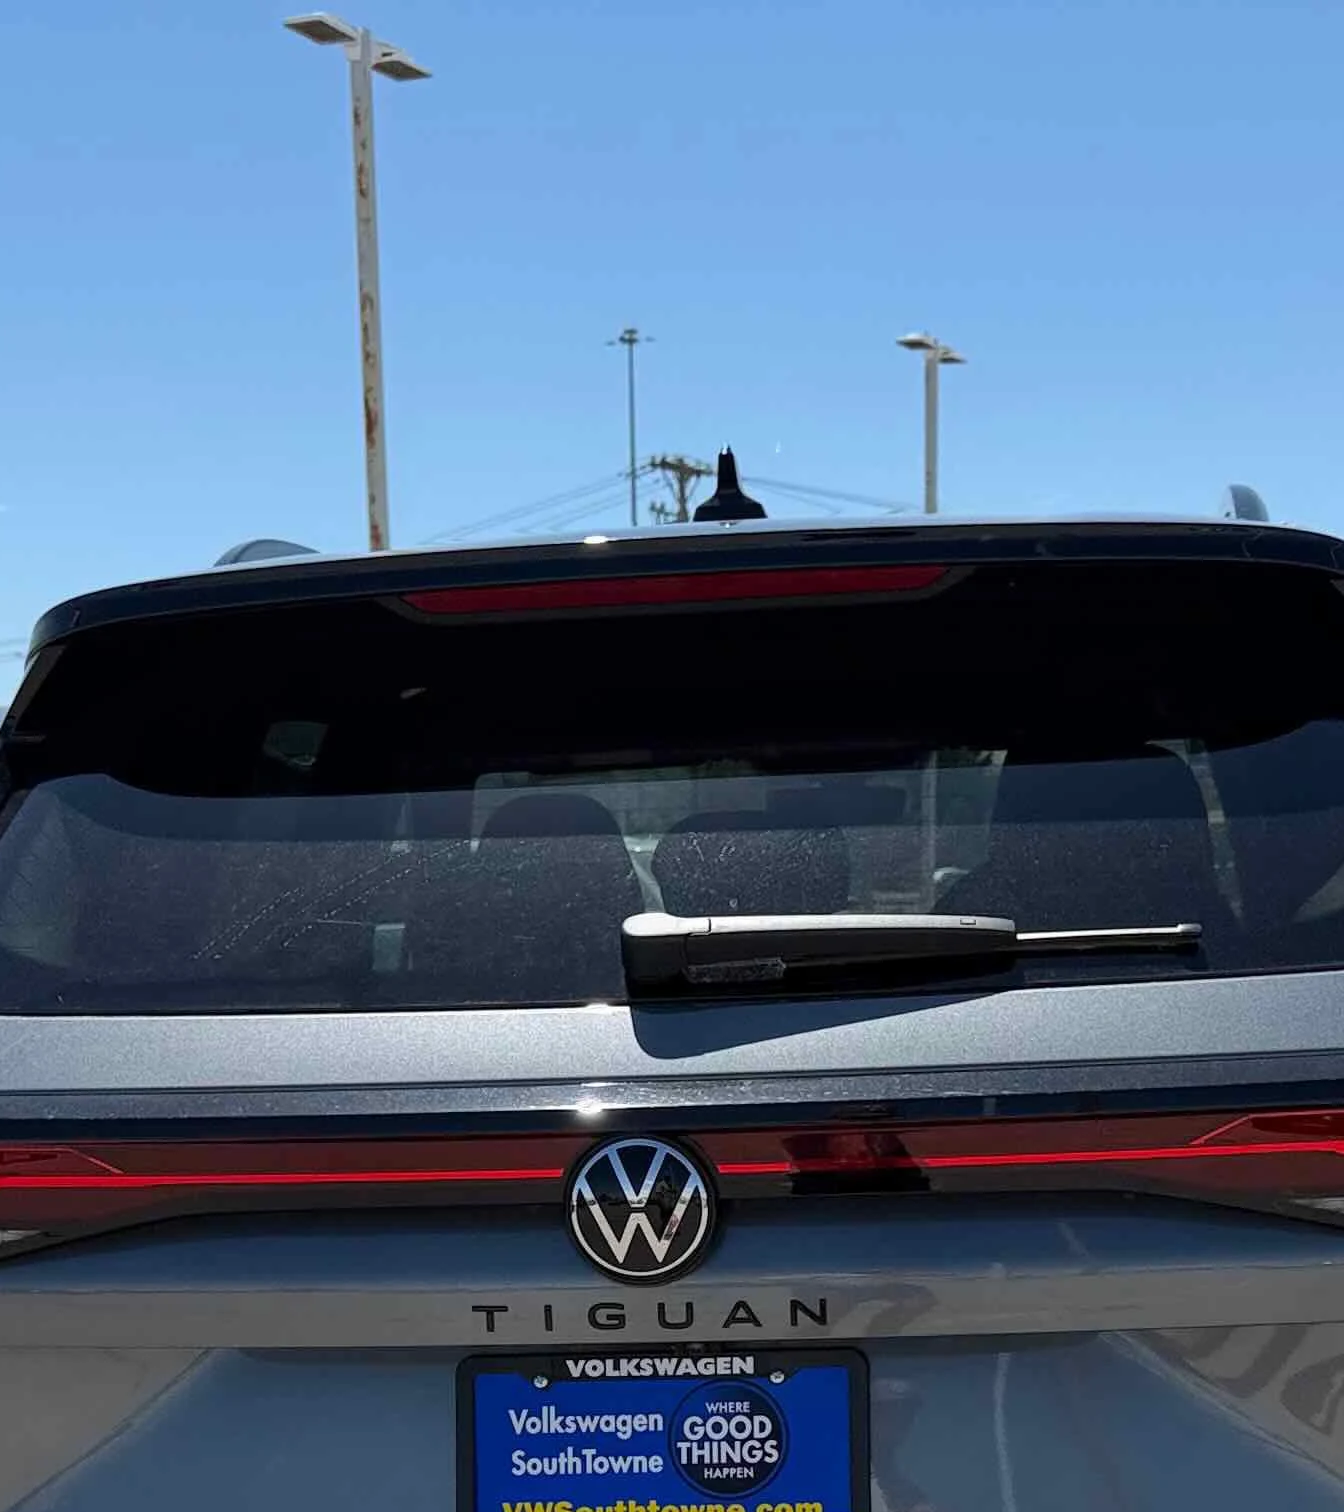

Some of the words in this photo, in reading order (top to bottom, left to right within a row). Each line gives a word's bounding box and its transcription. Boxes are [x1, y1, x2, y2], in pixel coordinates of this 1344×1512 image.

[570, 1138, 708, 1277] VW
[471, 1298, 829, 1333] TIGUAN
[565, 1355, 755, 1378] VOLKSWAGEN
[705, 1401, 751, 1414] WHERE
[508, 1405, 664, 1441] Volkswagen
[682, 1414, 773, 1442] GOOD
[510, 1446, 664, 1477] SouthTowne
[676, 1438, 779, 1466] THINGS
[703, 1466, 754, 1480] HAPPEN
